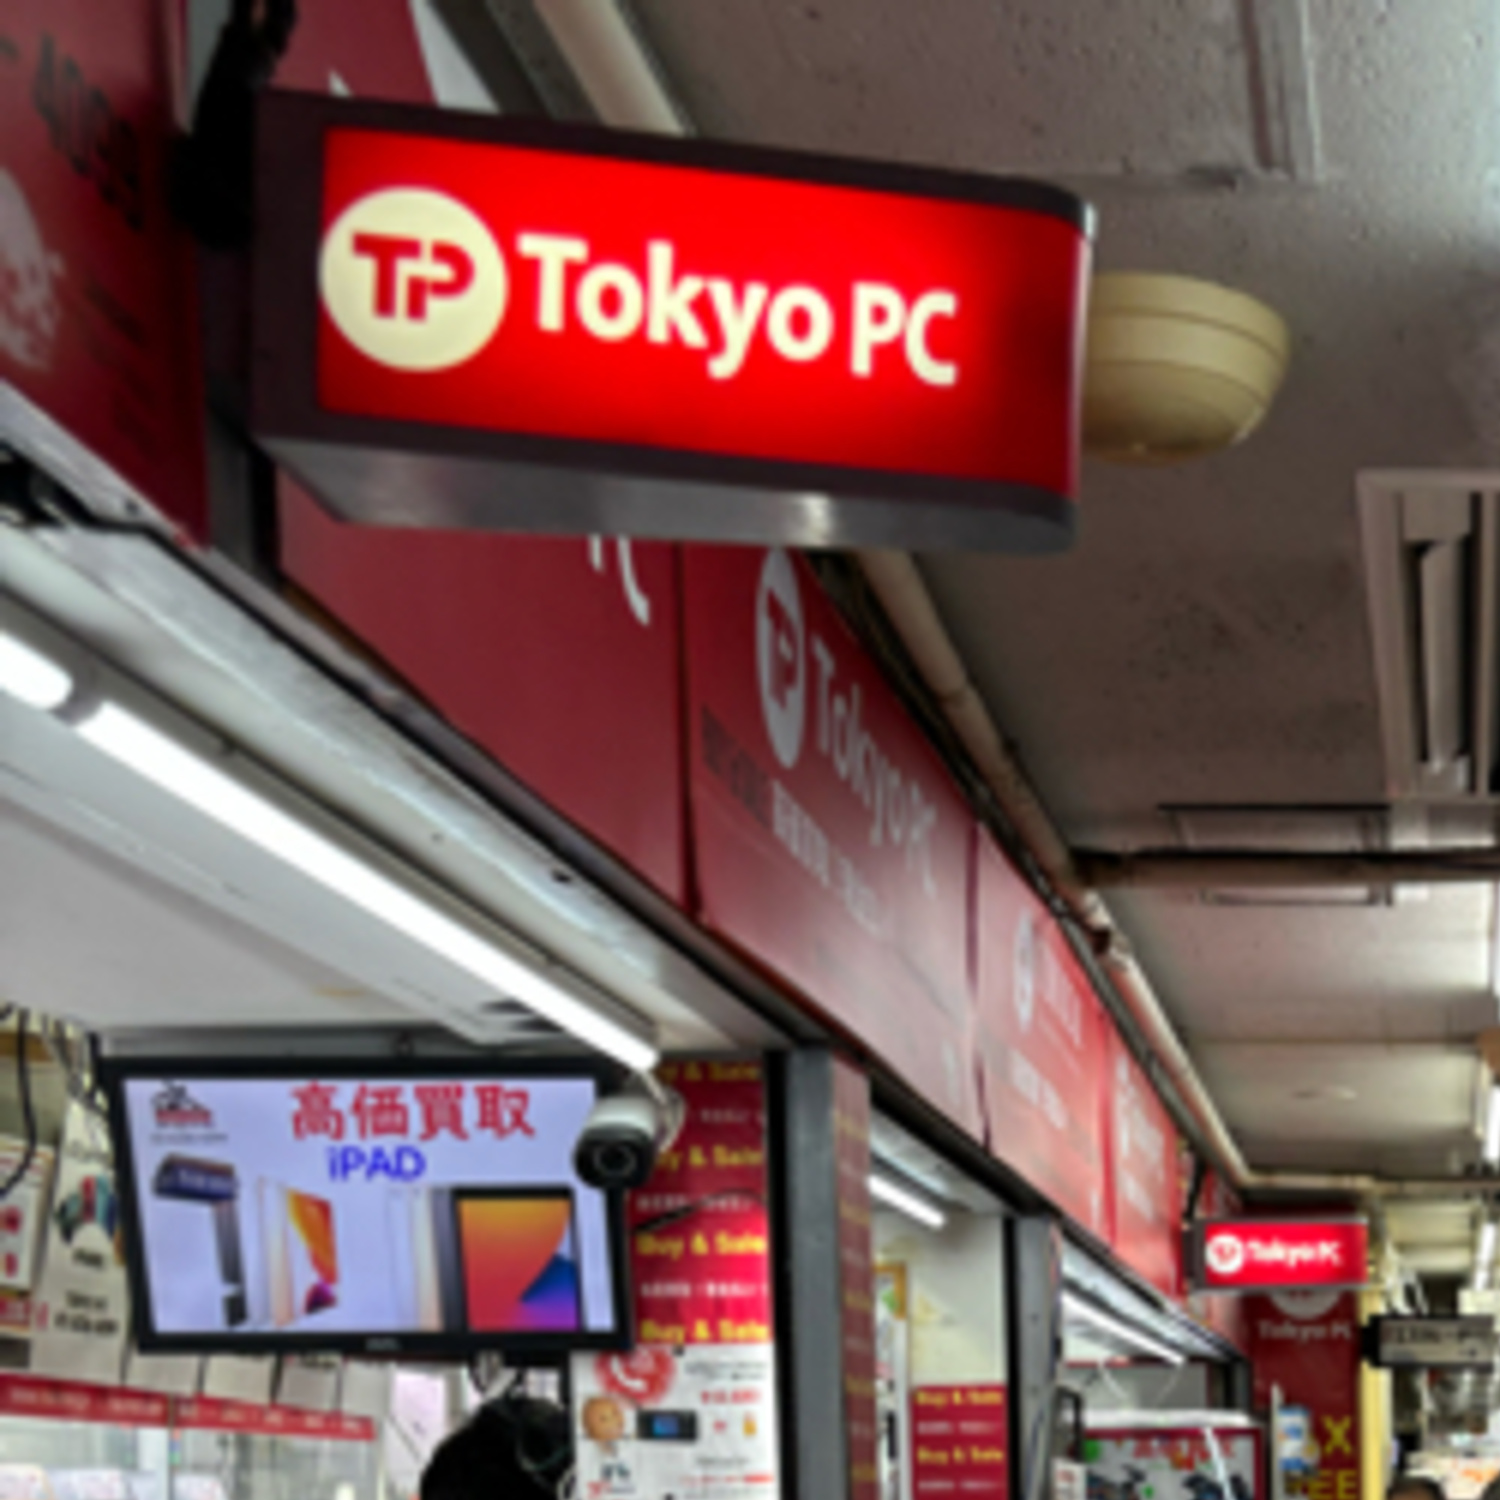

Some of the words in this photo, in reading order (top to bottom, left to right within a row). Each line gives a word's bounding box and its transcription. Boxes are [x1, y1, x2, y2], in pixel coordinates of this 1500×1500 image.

[516, 231, 835, 380] Tokyo
[850, 280, 958, 387] PC
[291, 1080, 535, 1142] 高価買取
[324, 1143, 428, 1183] iPAD
[1247, 1236, 1315, 1269] Tokyo
